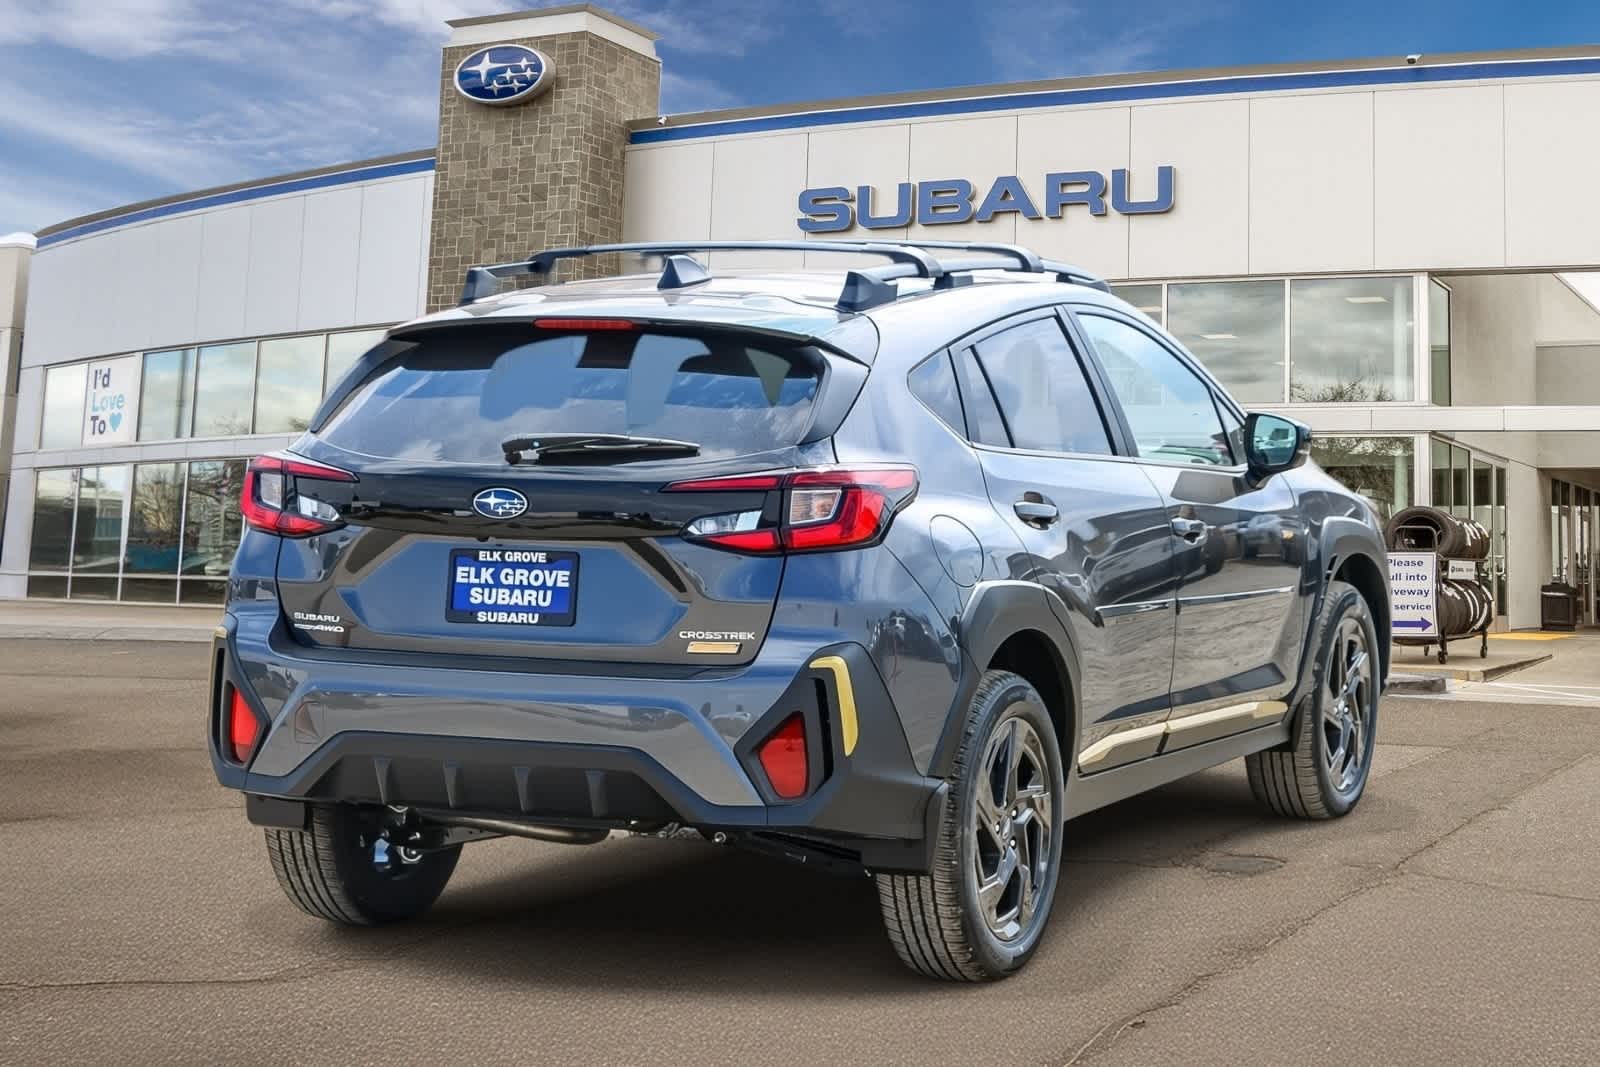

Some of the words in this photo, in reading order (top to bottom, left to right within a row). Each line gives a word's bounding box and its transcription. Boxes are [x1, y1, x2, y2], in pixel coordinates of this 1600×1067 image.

[796, 165, 1175, 233] SUBARU
[93, 368, 111, 389] I'd
[92, 392, 125, 412] Love
[91, 415, 106, 435] To
[479, 551, 501, 562] ELK
[504, 552, 547, 563] GROVE
[456, 566, 495, 584] ELK
[500, 568, 570, 588] GROVE
[1405, 573, 1428, 581] into
[469, 587, 552, 607] SUBARU
[294, 612, 340, 622] SUBARU
[477, 612, 539, 624] SUBARU
[679, 631, 755, 640] CROSSTREK
